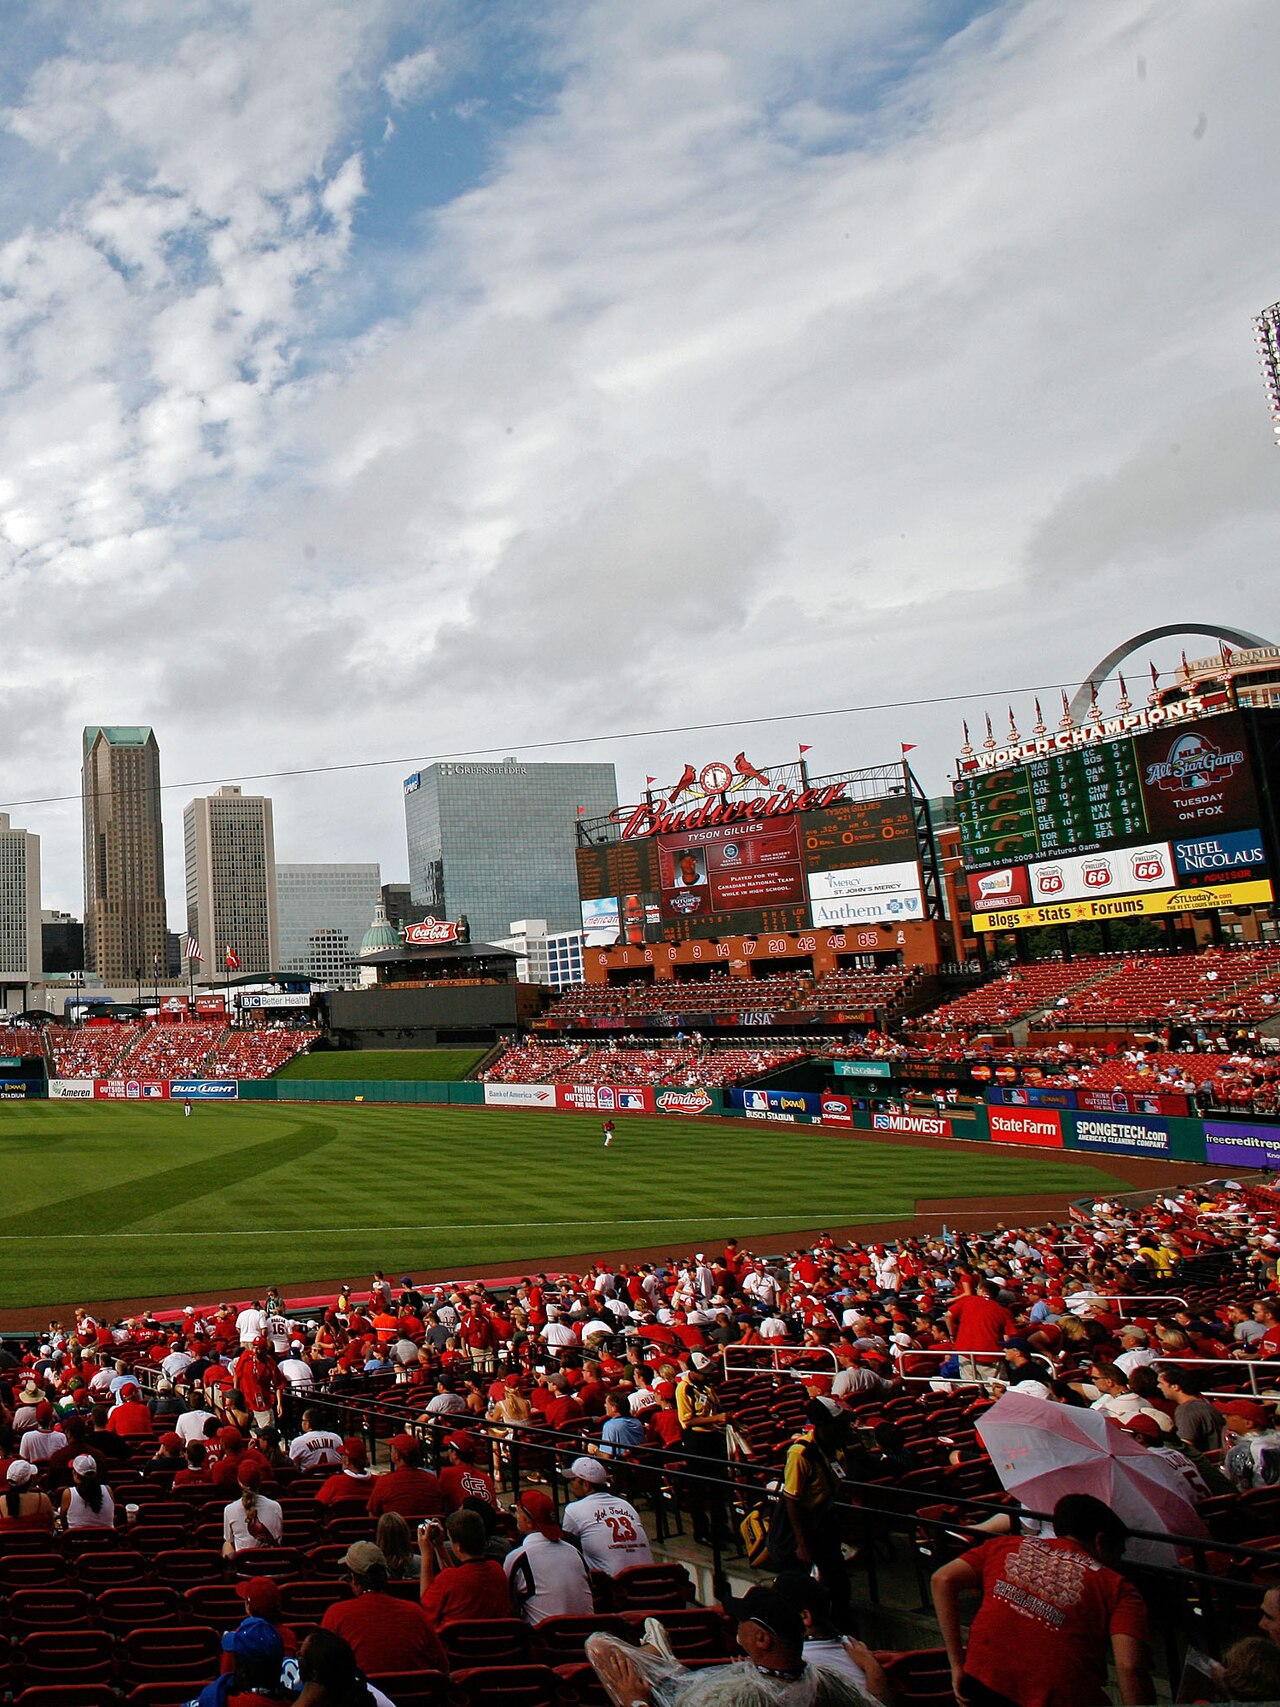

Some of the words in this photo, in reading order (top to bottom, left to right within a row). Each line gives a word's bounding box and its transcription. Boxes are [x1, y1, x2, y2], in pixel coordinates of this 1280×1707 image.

[1216, 674, 1232, 682] 2006
[976, 740, 1049, 768] WORLD
[1055, 699, 1204, 748] CHAMPIONS
[1082, 749, 1095, 758] KC
[1030, 761, 1048, 770] WAS
[1083, 755, 1102, 765] BOS
[1085, 766, 1105, 776] OAK
[1146, 763, 1172, 785] All
[1172, 759, 1203, 778] Star
[1203, 750, 1244, 771] Game
[1031, 769, 1048, 778] HOU
[1087, 775, 1099, 783] TB
[1033, 780, 1049, 788] ATL
[1088, 784, 1109, 794] CHW
[1034, 787, 1050, 795] COL
[1089, 792, 1107, 802] MIN
[1115, 788, 1126, 796] 13
[1173, 793, 1223, 808] TUESDAY
[610, 781, 846, 840] Budweiser
[824, 807, 851, 816] TYSON
[851, 803, 881, 812] GILLIES
[1091, 803, 1110, 813] NYY
[1179, 810, 1195, 820] ON
[1197, 805, 1223, 819] FOX
[1037, 814, 1053, 823] CLE
[1092, 810, 1111, 820] LAA
[1039, 822, 1055, 830] DET
[1094, 822, 1112, 830] TEX
[687, 830, 720, 842] TYSON
[724, 823, 764, 836] GILLIES
[1040, 832, 1057, 840] TOR
[1095, 830, 1114, 839] SEA
[1041, 839, 1059, 848] BAL
[1177, 841, 1223, 858] STIFEL
[964, 862, 991, 870] Welcome
[1014, 853, 1033, 862] 2009
[1048, 847, 1076, 857] Futures
[1134, 854, 1158, 862] PHILLIPS
[1184, 848, 1263, 870] NICOLAUS
[1085, 862, 1107, 870] PHILLIPS
[1138, 863, 1159, 877] 66
[833, 877, 862, 887] MERCY
[981, 876, 1010, 890] StubHub!
[1088, 872, 1106, 884] 66
[846, 886, 873, 894] JOHN'S
[874, 883, 902, 891] MERCY
[1042, 879, 1059, 890] 66
[670, 896, 701, 905] FUTURES
[817, 903, 883, 921] Anthem
[988, 914, 1020, 928] Blogs
[1038, 906, 1071, 922] Stats
[1091, 899, 1144, 916] Forums
[412, 924, 450, 940] Coca-Cola
[622, 951, 628, 963] 1
[645, 949, 654, 962] 2
[668, 948, 677, 960] 6
[693, 946, 702, 958] 9
[716, 943, 730, 957] 14
[742, 941, 757, 955] 17
[768, 939, 786, 953] 20
[798, 937, 816, 951] 42
[827, 935, 847, 949] 45
[858, 932, 879, 947] 85
[243, 997, 260, 1006] BJC
[262, 996, 283, 1006] Better
[285, 995, 309, 1005] Health
[744, 1012, 771, 1025] USA
[61, 1088, 90, 1097] Ameren
[172, 1085, 197, 1093] BUD
[202, 1085, 235, 1093] LIGHT
[573, 1086, 595, 1094] THINK
[564, 1093, 596, 1102] OUTSIDE
[1085, 1098, 1112, 1106] OUTSIDE
[828, 1103, 843, 1112] Ford
[745, 1110, 766, 1119] BUSCH
[766, 1112, 795, 1122] STADIUM
[890, 1116, 946, 1134] MIDWEST
[991, 1116, 1023, 1133] State
[1023, 1118, 1056, 1135] Farm
[1076, 1121, 1167, 1142] SPONGETECH.com
[1078, 1134, 1107, 1143] AMERICA'S
[1107, 1136, 1136, 1146] CLEANING
[272, 1323, 285, 1335] 16
[306, 1439, 334, 1453] MOLINA
[604, 1516, 637, 1543] 23
